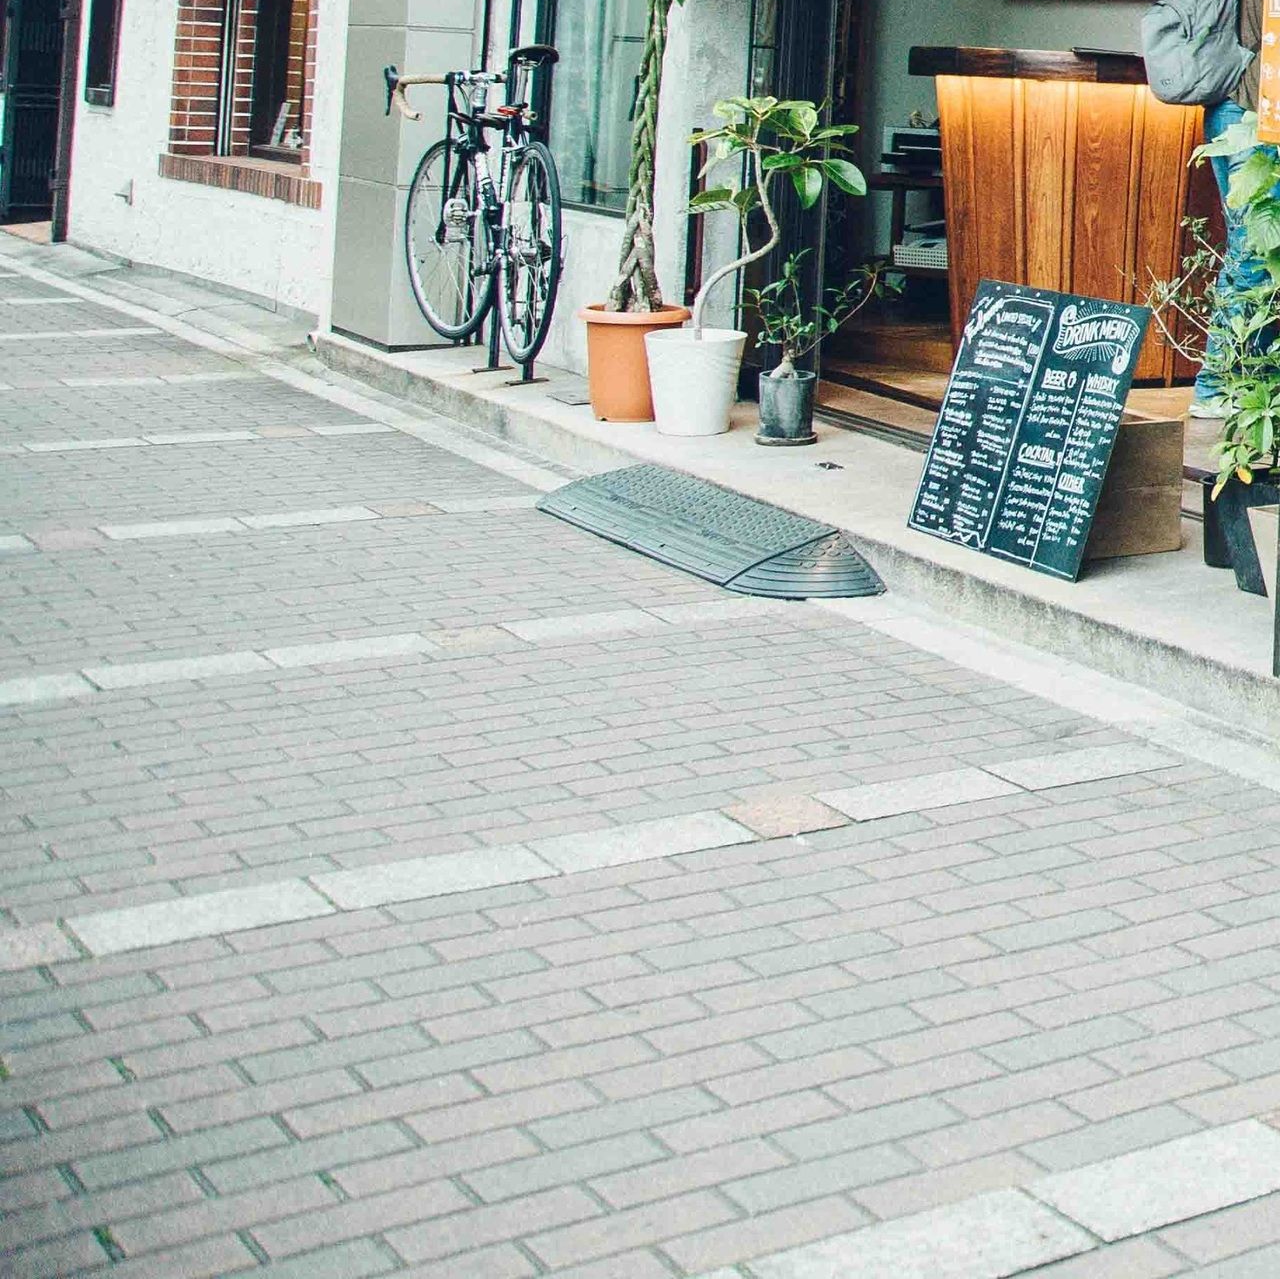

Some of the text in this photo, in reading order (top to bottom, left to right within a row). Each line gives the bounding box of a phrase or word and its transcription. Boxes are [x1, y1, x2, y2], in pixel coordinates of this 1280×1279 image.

[1064, 322, 1131, 347] DRINK MENU
[1043, 369, 1120, 394] BEER WHISKY
[1019, 444, 1056, 465] COCKTAIL
[1058, 472, 1086, 491] OTHER
